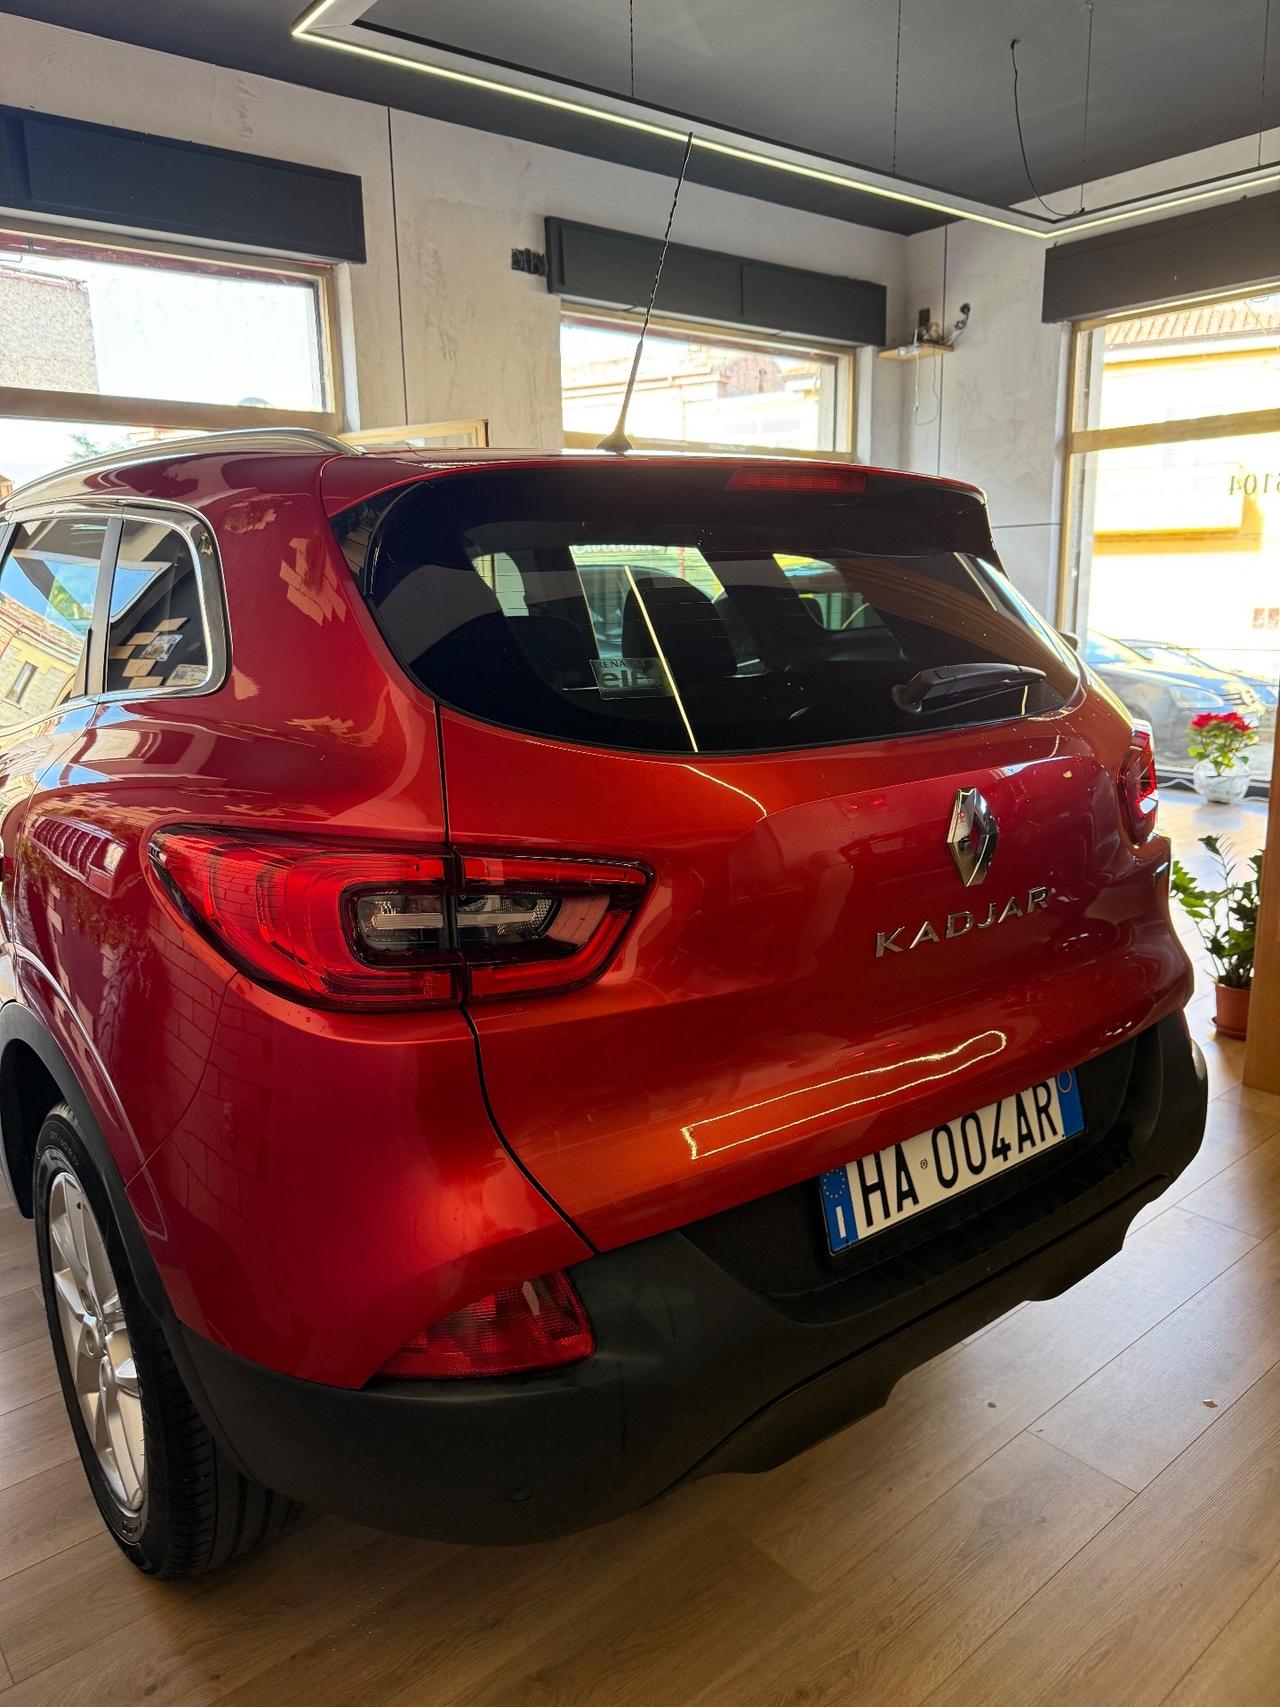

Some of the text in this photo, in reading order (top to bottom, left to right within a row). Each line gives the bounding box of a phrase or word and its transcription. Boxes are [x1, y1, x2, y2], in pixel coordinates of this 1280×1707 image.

[876, 886, 1049, 958] KADJAR
[856, 1143, 919, 1228] HA
[931, 1082, 1058, 1189] 004AR
